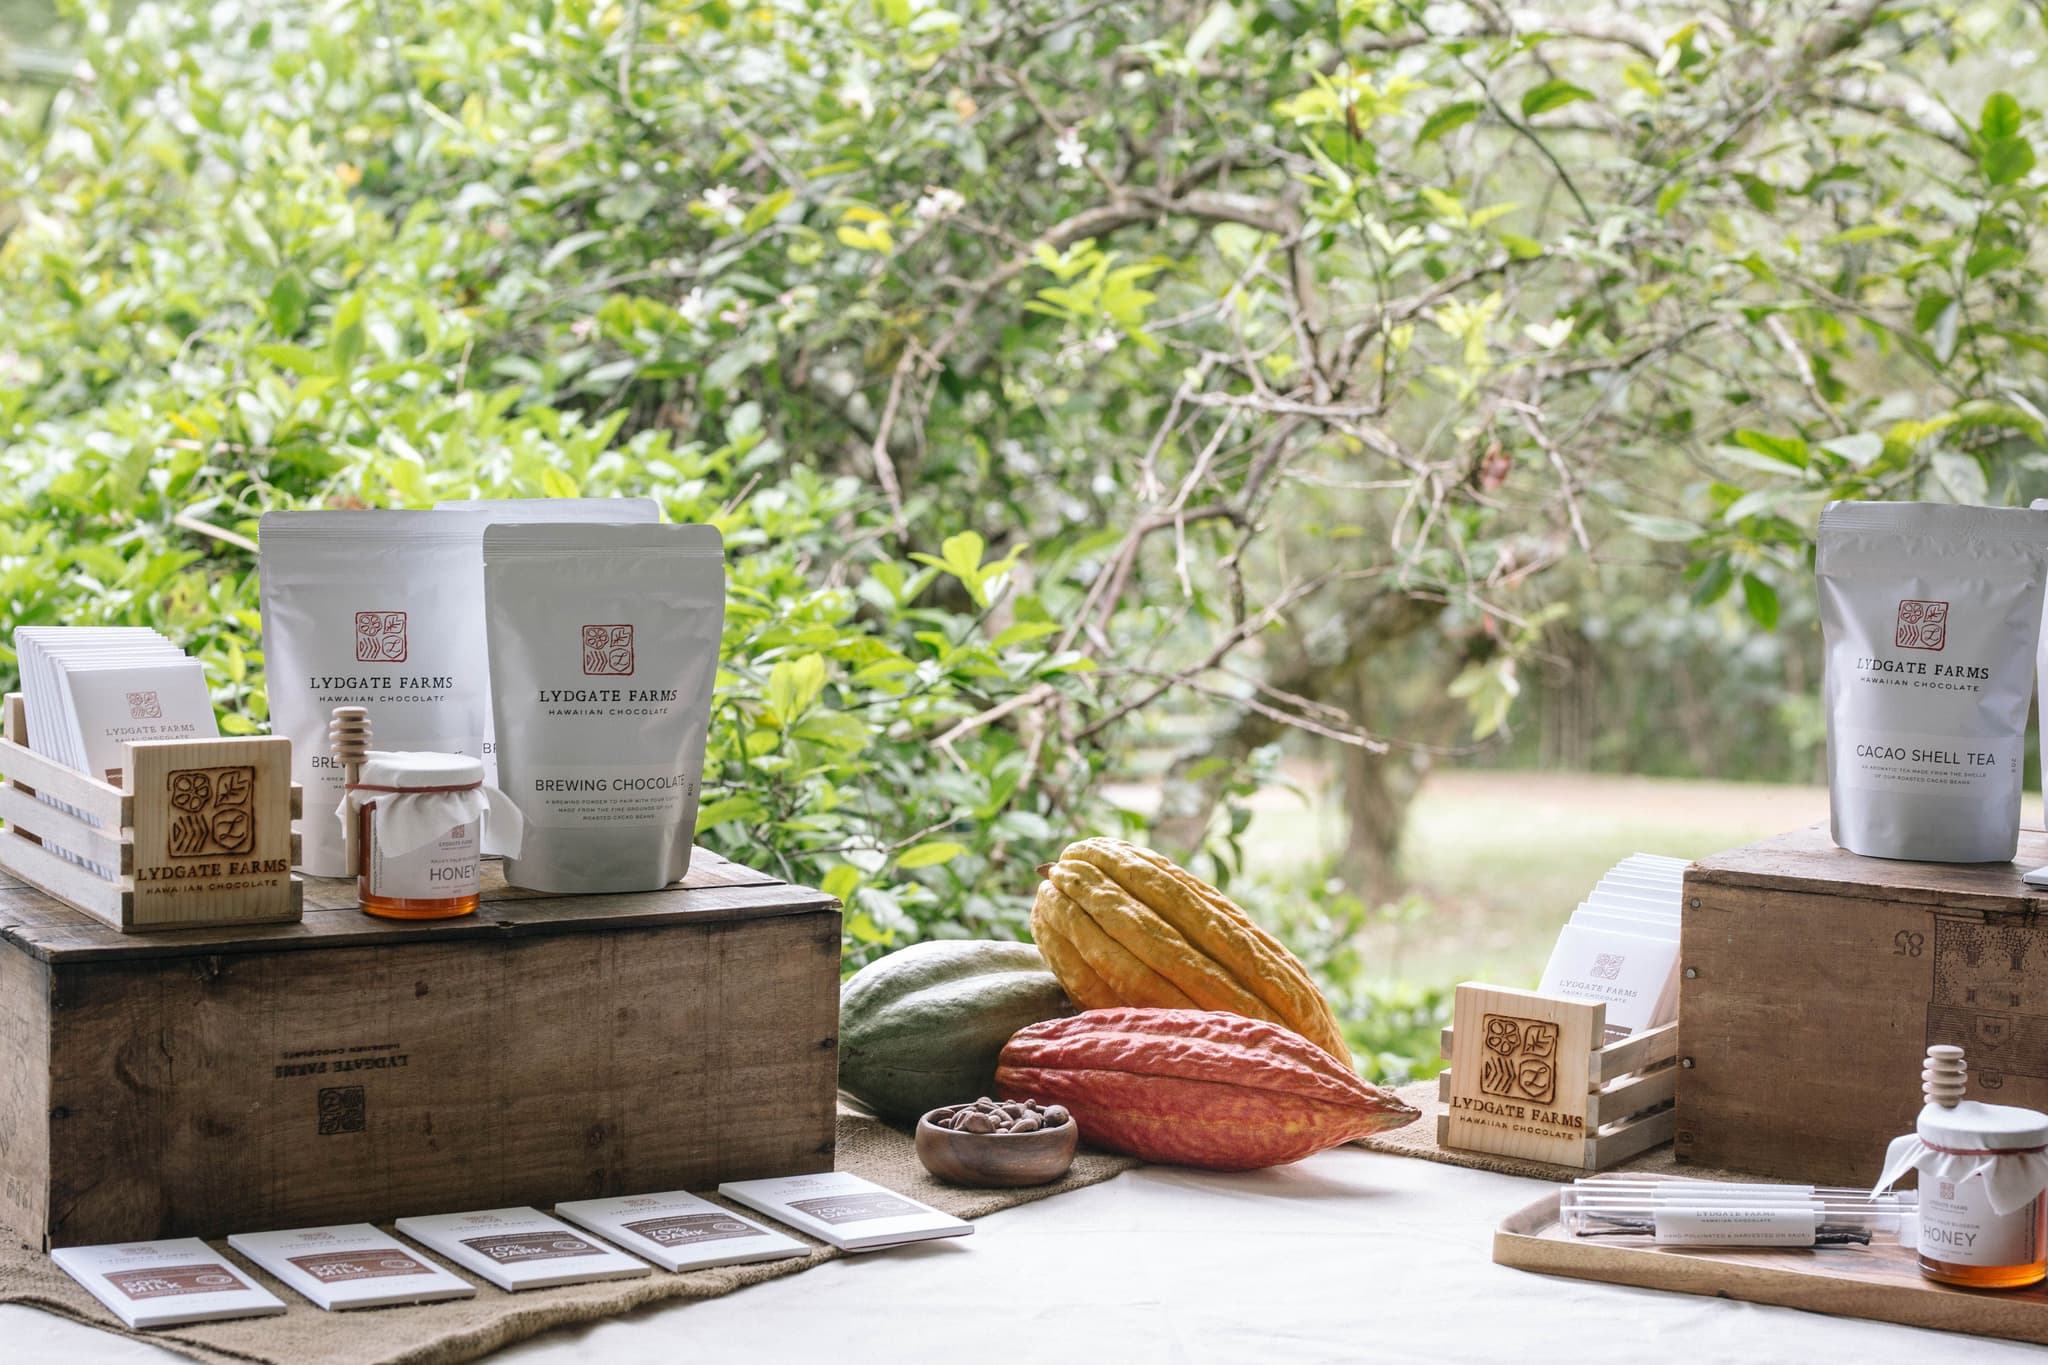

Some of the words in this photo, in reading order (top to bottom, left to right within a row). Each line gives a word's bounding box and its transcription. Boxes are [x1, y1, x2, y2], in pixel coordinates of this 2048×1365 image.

[1857, 657, 1927, 675] LYDGATE
[1934, 664, 1990, 680] FARMS
[310, 677, 391, 689] LYDGATE
[399, 676, 453, 689] FARMS
[1860, 677, 1909, 686] HAWAIIAN
[1914, 681, 1980, 693] CHOCOLATE
[319, 695, 374, 703] HAWAIIAN
[379, 695, 445, 703] CHOCOLATE
[539, 690, 621, 702] LYDGATE
[629, 689, 678, 701] FARMS
[609, 708, 668, 716] CHOCOLATE
[105, 725, 158, 737] LYDGATE
[160, 723, 196, 735] FARMS
[1856, 744, 1906, 761] CACAO
[1911, 749, 1961, 765] SHELL
[1967, 752, 1996, 766] TEA
[535, 779, 607, 792] BREWING
[612, 774, 685, 791] CHOCOLATE
[137, 862, 222, 882] LYDGATE
[229, 859, 288, 875] FARMS
[430, 864, 477, 881] HONEY
[146, 883, 203, 895] HAWAIIAN
[208, 879, 279, 891] CHOCOLATE
[1559, 978, 1602, 993] LYDGATE
[1606, 985, 1639, 998] FARMS
[333, 1054, 409, 1073] LYDGATE
[1452, 1096, 1525, 1119] LYDGATE
[1531, 1108, 1583, 1128] FARMS
[1460, 1115, 1508, 1130] HAWAIIAN
[1512, 1123, 1574, 1141] CHOCOLATE
[655, 1229, 709, 1241] DARK
[1924, 1224, 1977, 1247] HONEY
[493, 1246, 548, 1258] DARK
[317, 1265, 369, 1277] MILK
[127, 1282, 183, 1294] MILK
